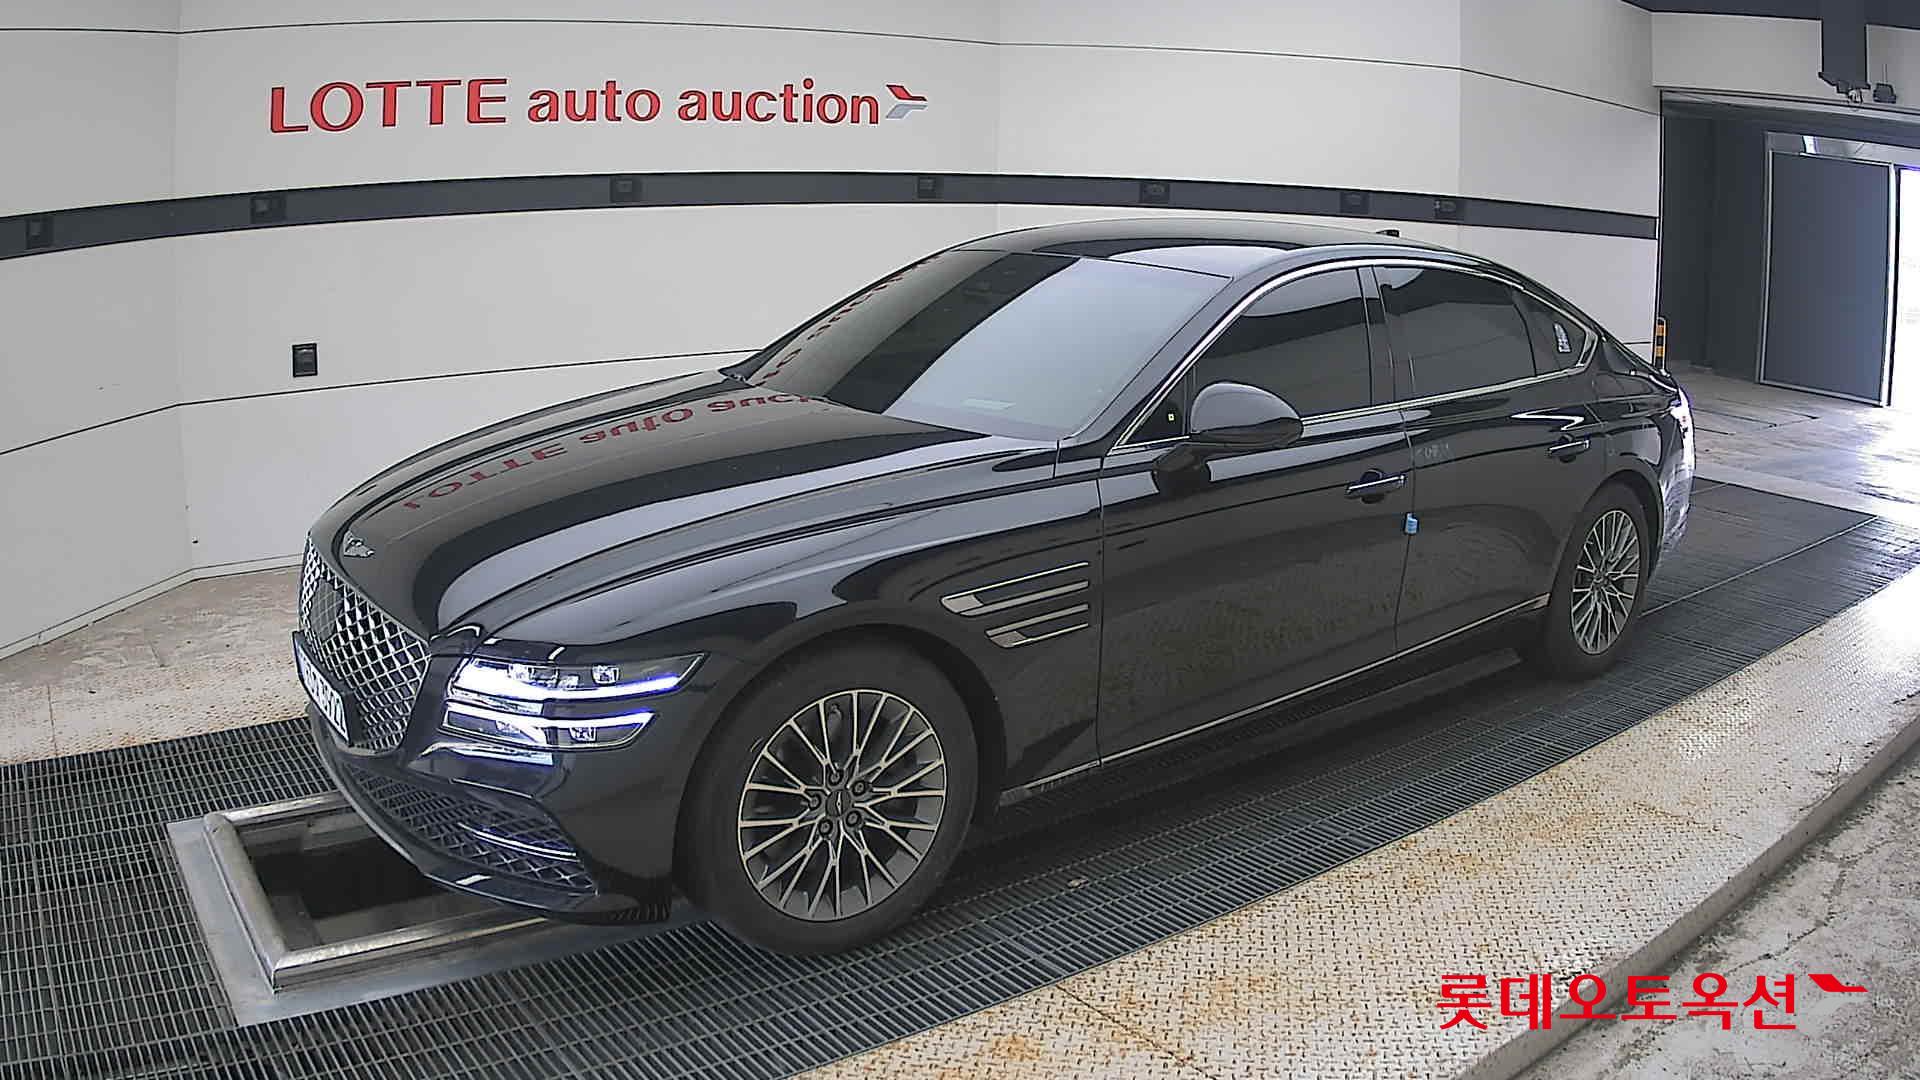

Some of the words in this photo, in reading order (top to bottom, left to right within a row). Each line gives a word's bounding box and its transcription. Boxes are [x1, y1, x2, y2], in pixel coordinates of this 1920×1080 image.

[269, 78, 507, 134] LOTTE
[527, 80, 662, 124] auto
[677, 78, 879, 125] auction
